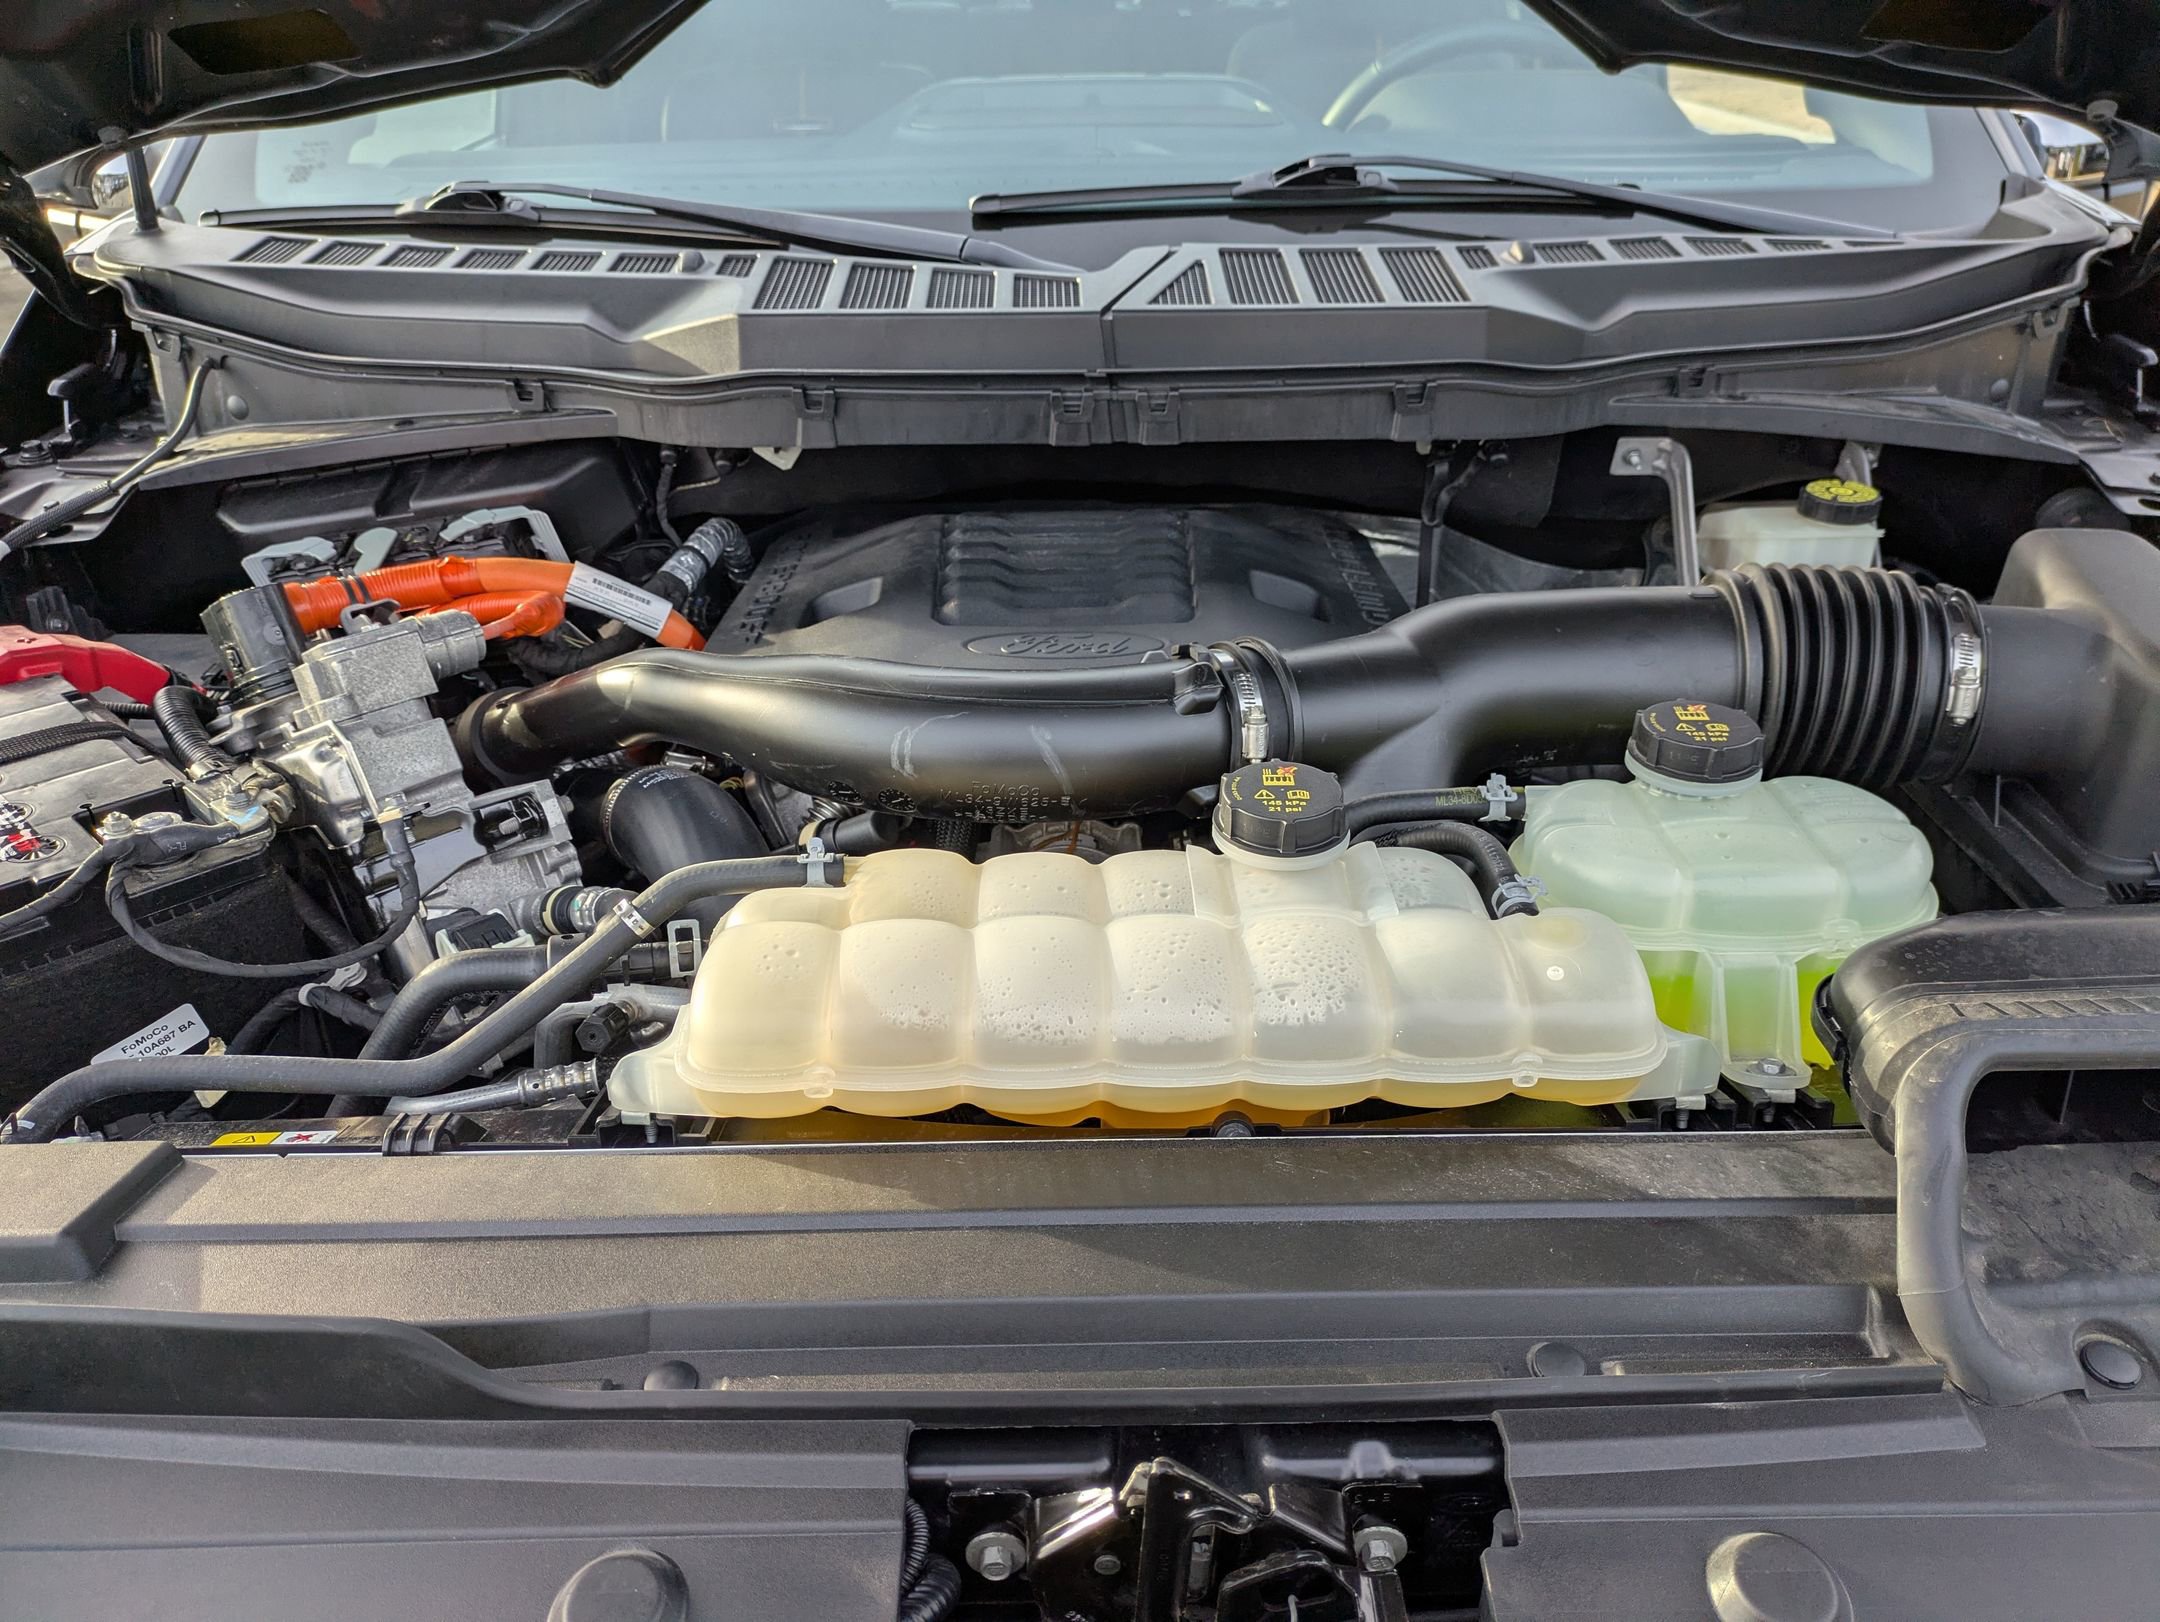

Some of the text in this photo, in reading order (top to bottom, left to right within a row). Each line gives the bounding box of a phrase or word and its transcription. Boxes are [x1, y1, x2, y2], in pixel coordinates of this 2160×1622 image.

[1000, 634, 1129, 655] Ford
[121, 1024, 169, 1055] FoMoCo
[138, 1020, 196, 1057] 10A687 BA
